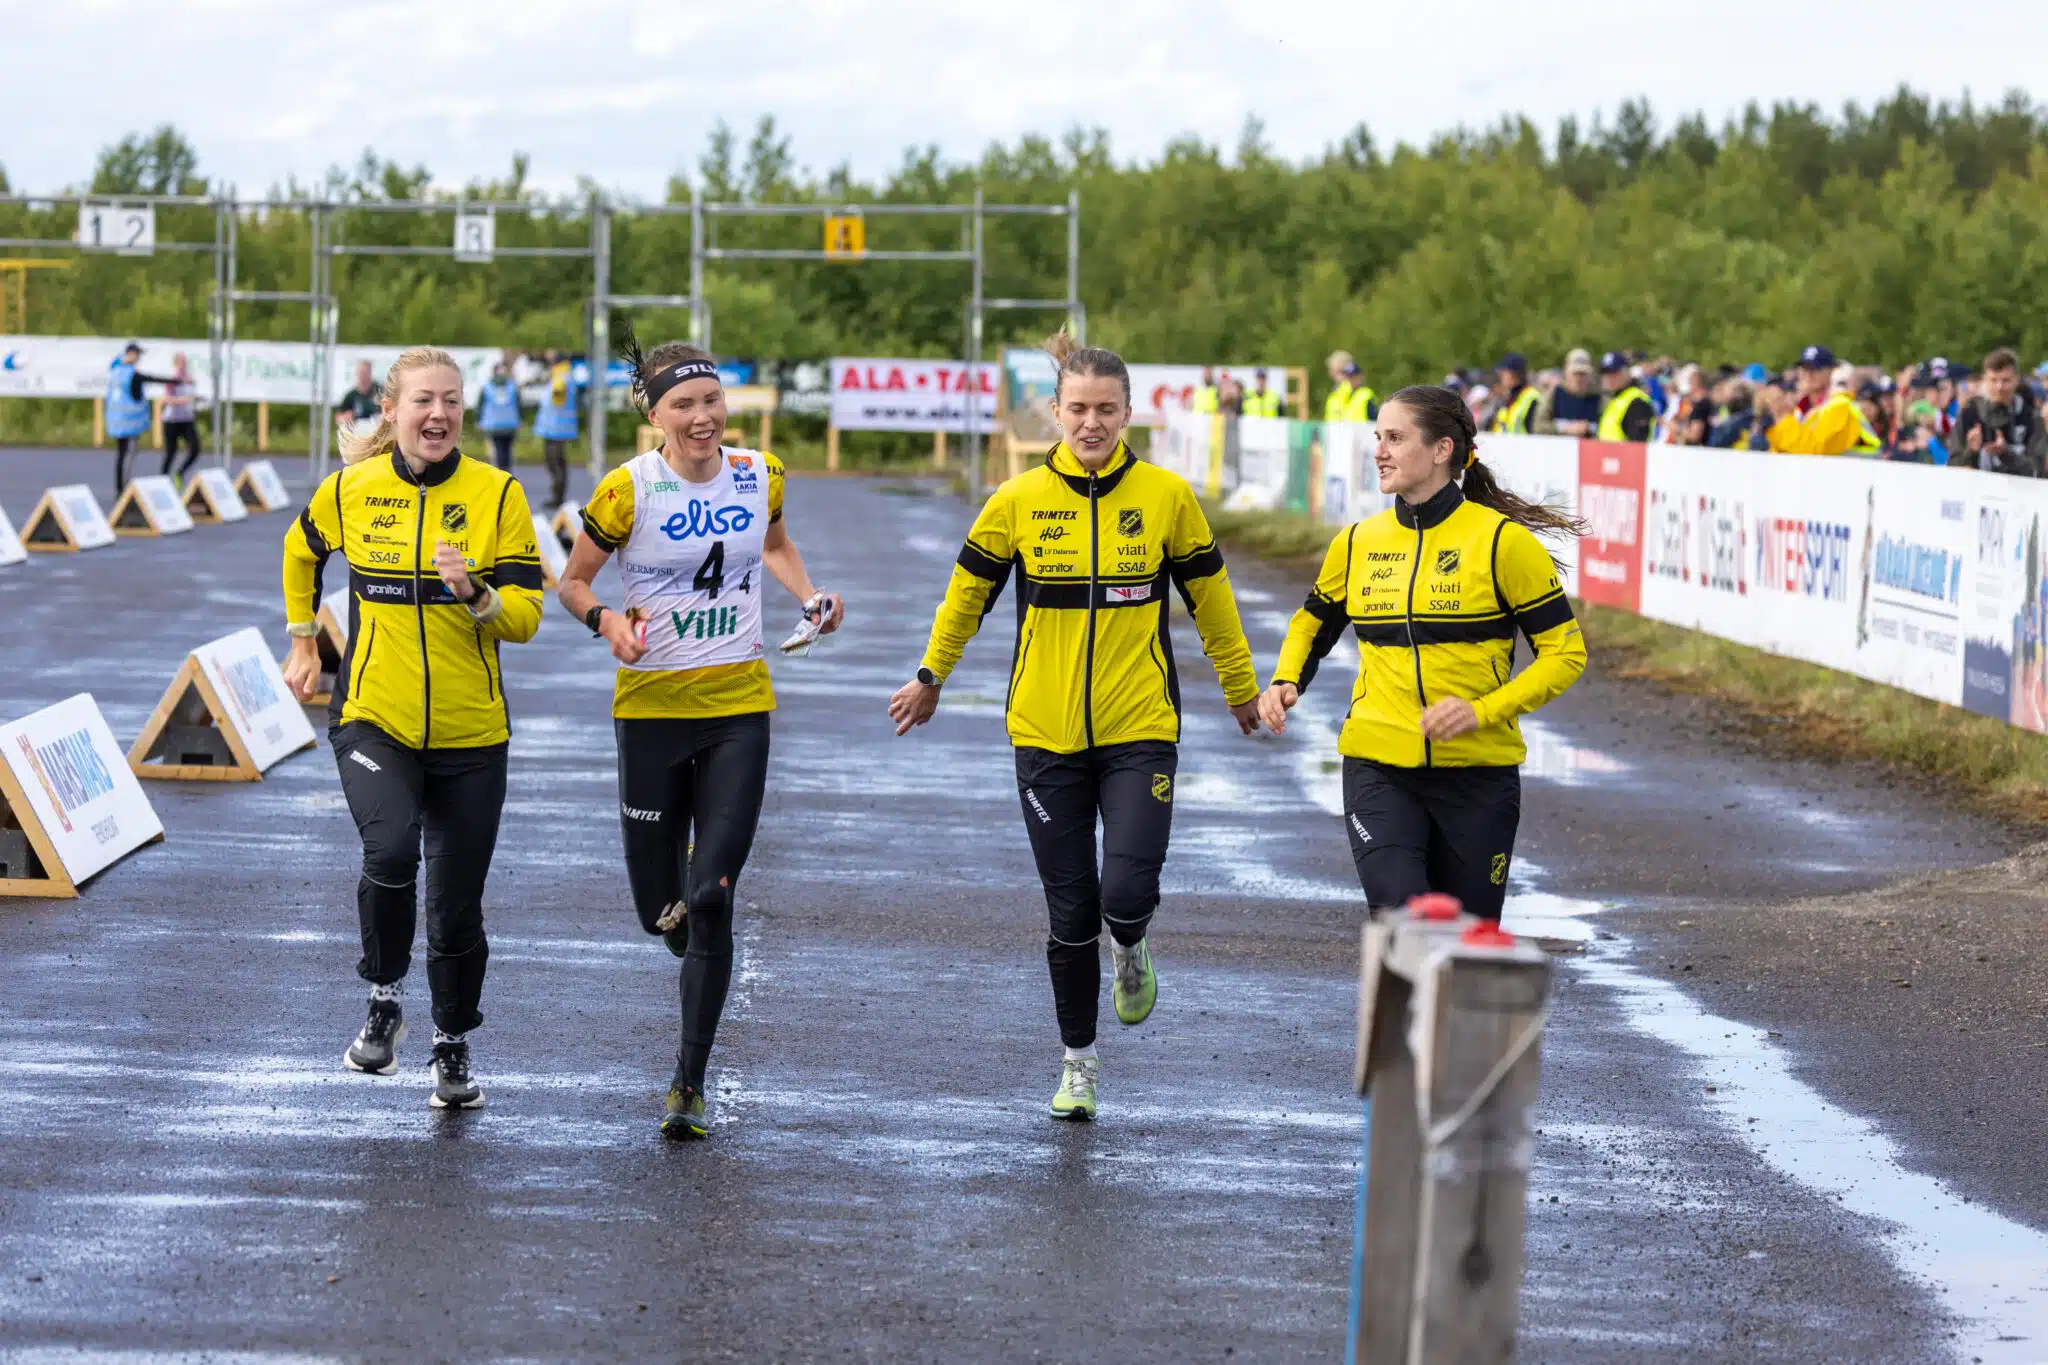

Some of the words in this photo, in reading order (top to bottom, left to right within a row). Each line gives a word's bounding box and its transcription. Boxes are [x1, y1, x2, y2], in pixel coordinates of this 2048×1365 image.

[90, 214, 102, 246] 1
[124, 215, 145, 249] 2
[465, 220, 484, 254] 3
[840, 366, 906, 391] ALA
[364, 496, 412, 509] TRIMTEX
[660, 499, 755, 541] elisa
[1031, 510, 1079, 521] TRIMTEX
[441, 539, 469, 552] iati
[1116, 543, 1147, 556] viati
[368, 550, 401, 564] SSAB
[1367, 551, 1408, 562] TRIMTEX
[692, 540, 725, 600] 4
[1036, 561, 1074, 574] granitor
[1116, 561, 1146, 573] SSAB
[739, 570, 752, 595] 4
[1430, 580, 1461, 594] viati
[366, 583, 406, 598] granitor
[1363, 601, 1396, 614] granitor
[1428, 599, 1461, 611] SSAB
[671, 604, 738, 640] Villi
[1025, 787, 1052, 824] TRIMTEX
[1350, 812, 1374, 843] TRIMTEX
